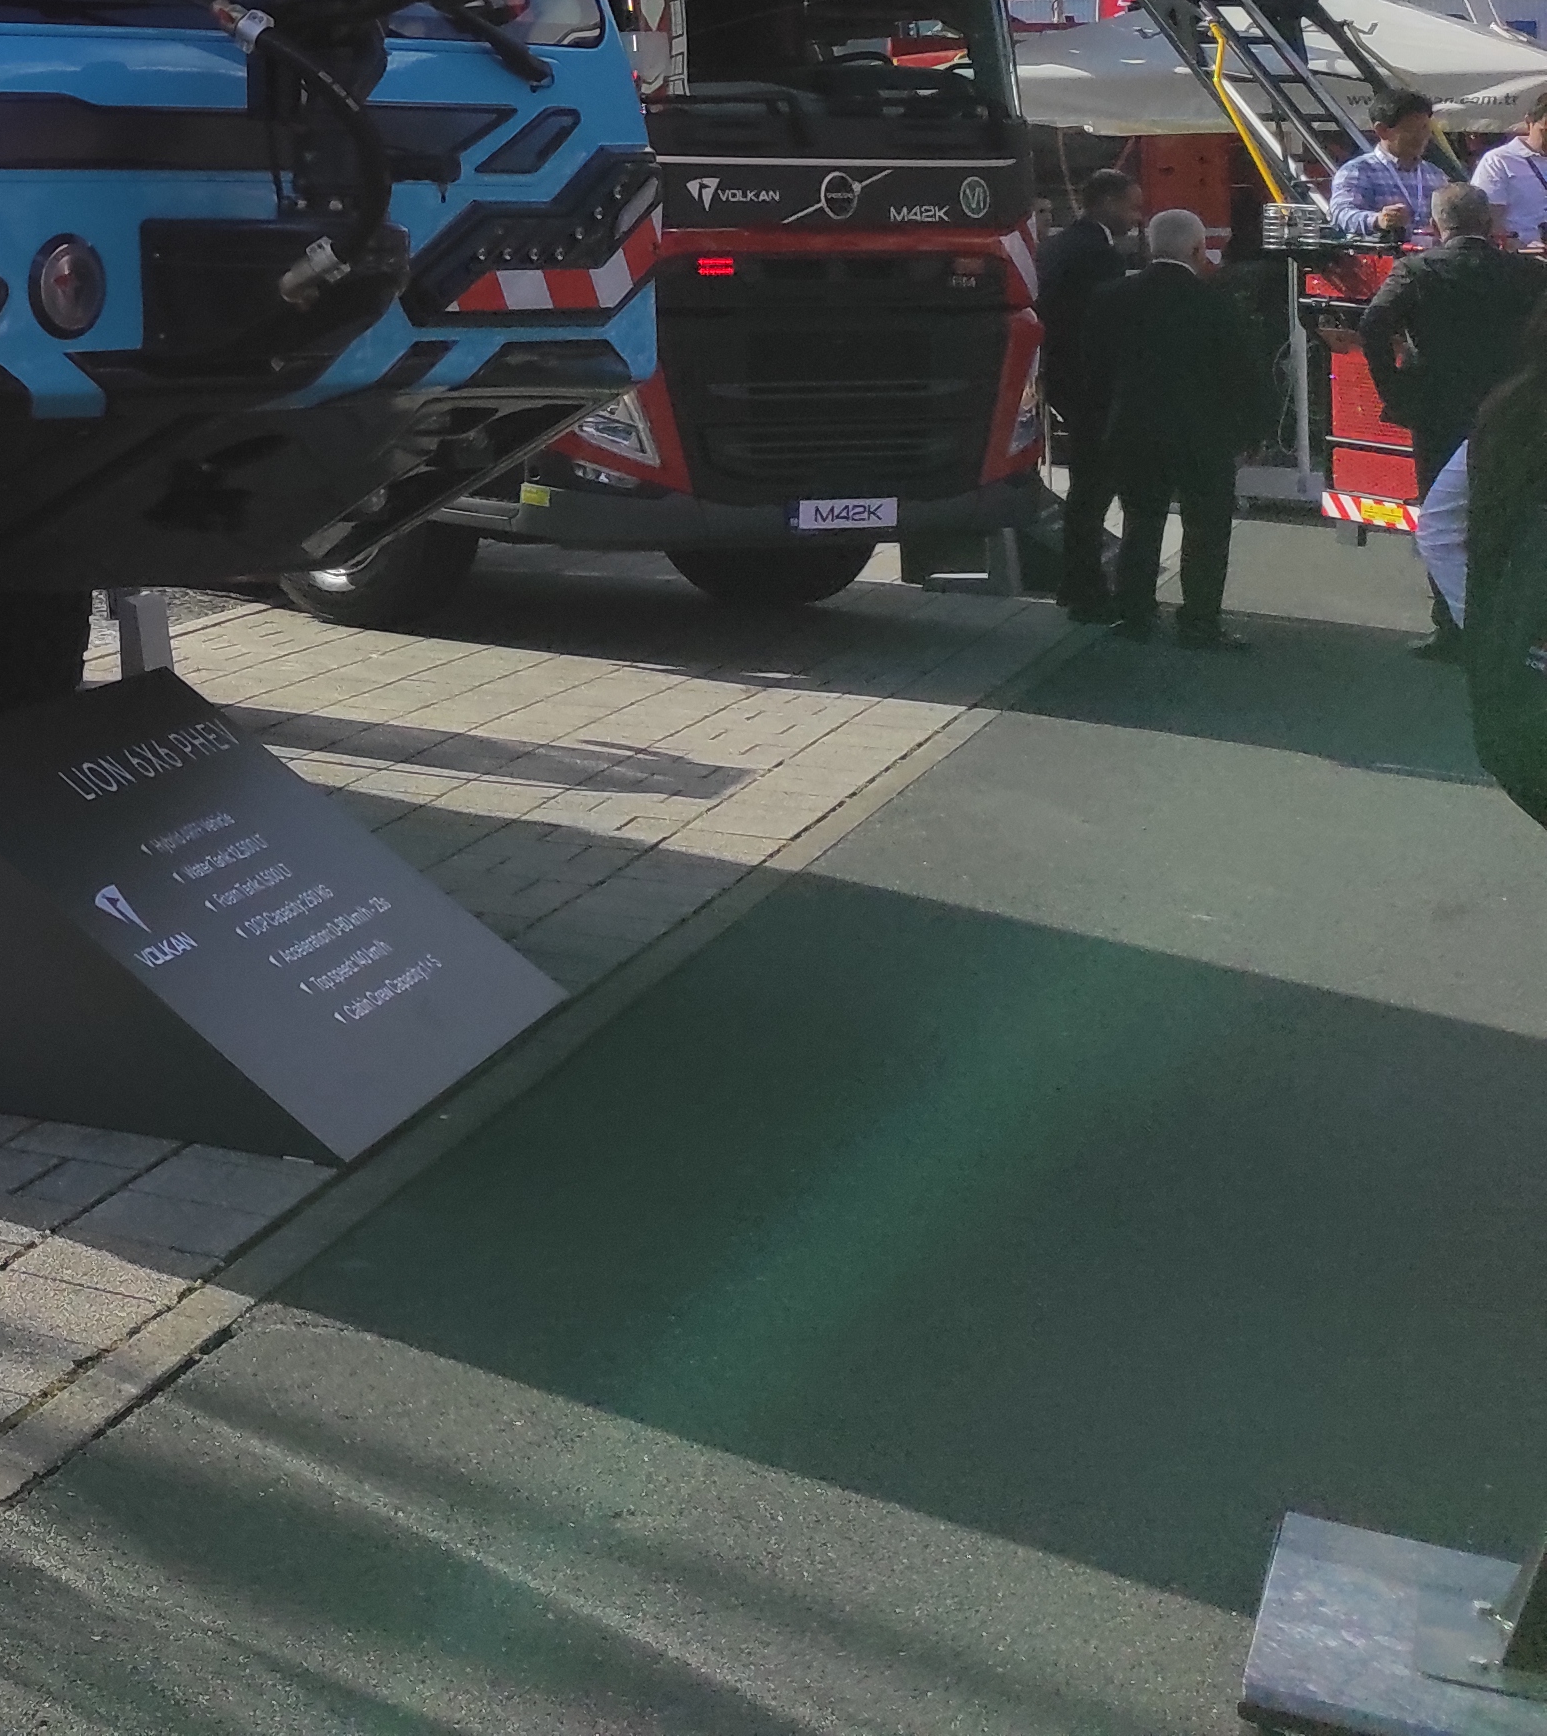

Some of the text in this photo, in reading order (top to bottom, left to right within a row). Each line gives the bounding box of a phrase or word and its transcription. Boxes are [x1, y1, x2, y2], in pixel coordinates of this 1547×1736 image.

[717, 189, 780, 203] VOLKAN
[889, 205, 950, 223] M42K
[814, 503, 883, 523] M42K
[57, 718, 242, 800] LION 6X6 PHEV
[298, 890, 321, 906] 250
[134, 930, 197, 969] VOLKAN
[276, 925, 334, 962] Acceleration:
[310, 972, 335, 992] Top
[343, 995, 374, 1020] Cabin
[366, 984, 394, 1005] Crew
